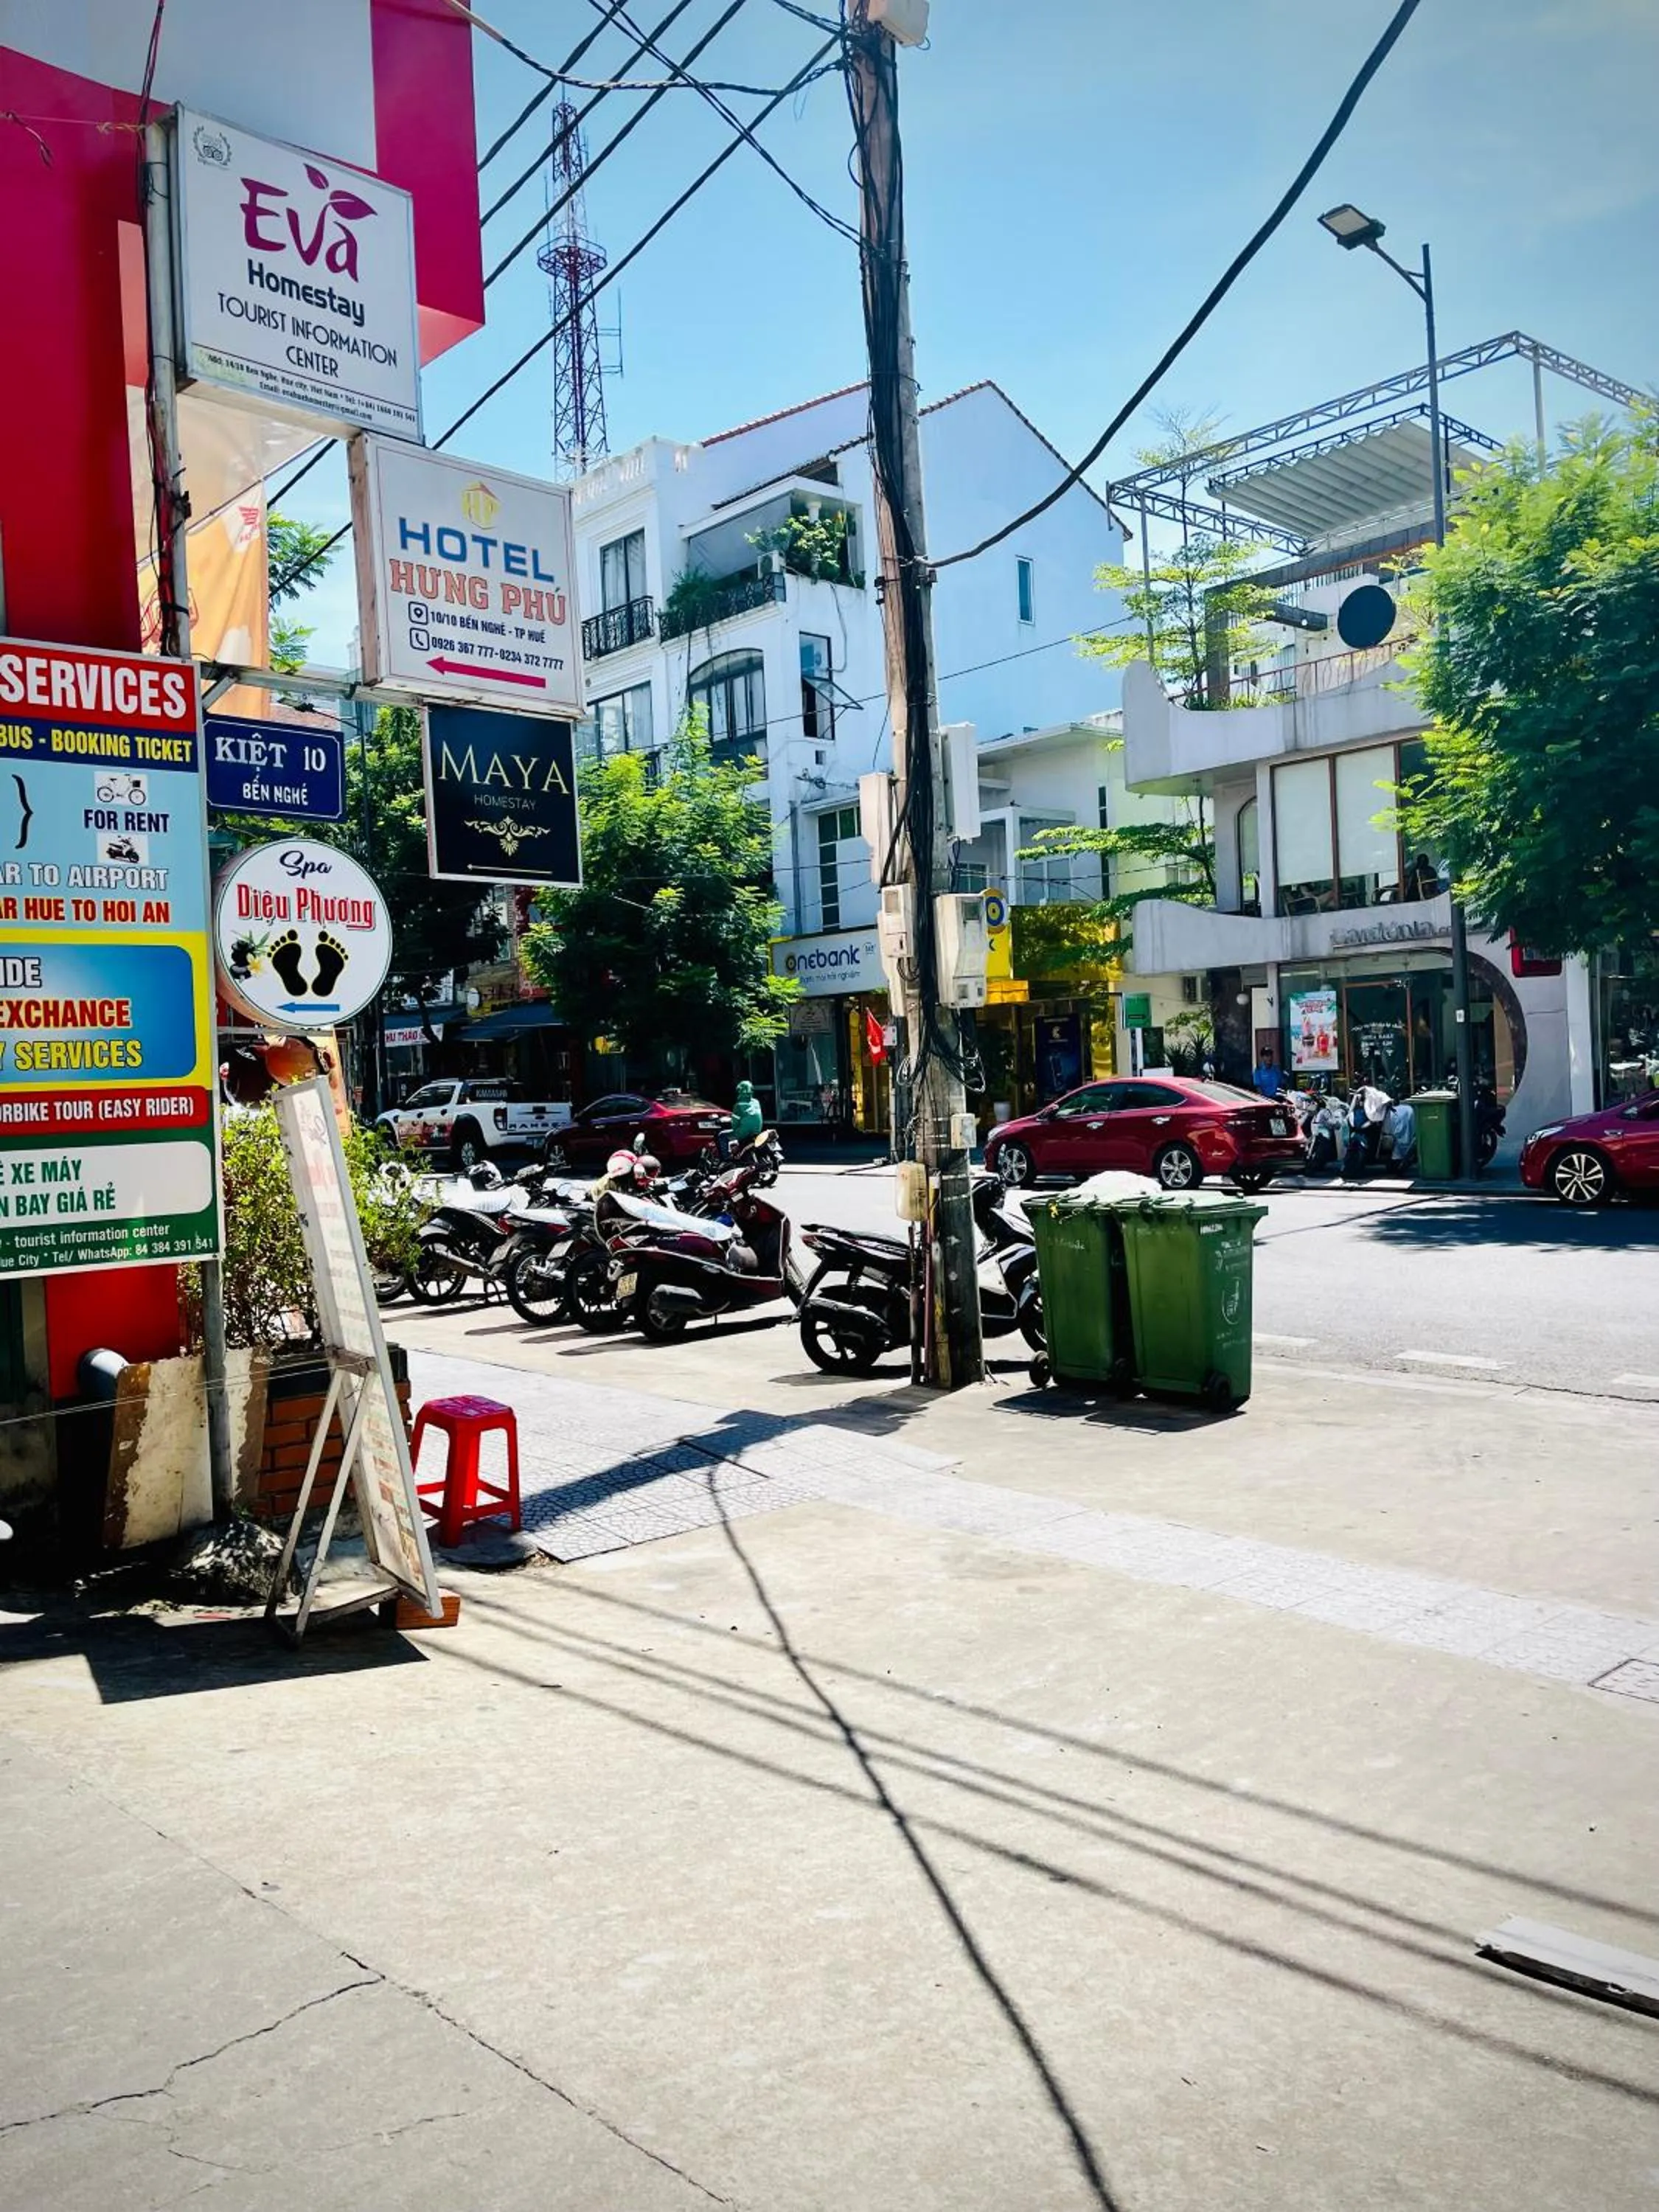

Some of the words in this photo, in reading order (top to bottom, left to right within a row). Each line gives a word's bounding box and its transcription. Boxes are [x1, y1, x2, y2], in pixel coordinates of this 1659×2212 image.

[240, 177, 359, 283] Eva
[247, 258, 366, 327] Homestay
[218, 293, 286, 333] TOURIST
[292, 316, 397, 368] INFORMATION
[286, 346, 339, 378] CENTER
[398, 516, 554, 583] HOTEL
[389, 558, 489, 611] HƯNG
[500, 582, 566, 626] PHÚ
[431, 611, 457, 626] 10/10
[515, 627, 525, 640] TP
[431, 636, 455, 651] 0926
[524, 653, 540, 667] 372
[0, 654, 187, 720] SERVICES
[0, 723, 33, 750] BUS
[51, 729, 131, 759] BOOKING
[135, 737, 192, 763] TICKET
[215, 732, 288, 772] KIỆT
[304, 745, 327, 772] 10
[438, 740, 571, 794] MAYA
[243, 774, 270, 801] BẾN
[274, 783, 309, 806] NGHÉ
[474, 793, 536, 811] HOMESTAY
[84, 808, 119, 831] FOR
[125, 811, 170, 833] RENT
[27, 862, 61, 887] TO
[68, 865, 170, 891] AIRPORT
[279, 850, 333, 879] Spa
[0, 896, 18, 921] R
[24, 897, 66, 922] HUE
[72, 897, 97, 922] TO
[102, 900, 136, 923] HOI
[142, 901, 171, 924] AN
[237, 883, 291, 926] Diệu
[296, 887, 377, 931] Phương
[15, 1040, 143, 1071] SERVICES
[53, 1100, 94, 1120] TOUR
[98, 1098, 142, 1120] (EASY
[145, 1096, 194, 1116] RIDER)
[11, 1162, 35, 1185] XE
[41, 1155, 82, 1183] MÁY
[15, 1193, 50, 1217] BAY
[57, 1186, 88, 1214] GIÁ
[93, 1181, 116, 1211] RẺ
[15, 1232, 57, 1248] tourist
[60, 1226, 128, 1244] information
[133, 1224, 170, 1238] center
[0, 1257, 15, 1267] ue
[18, 1253, 40, 1267] City
[52, 1250, 74, 1263] Tel/
[77, 1246, 132, 1261] WhatsApp:
[135, 1243, 147, 1255] 84
[151, 1241, 170, 1253] 384
[173, 1239, 191, 1252] 391
